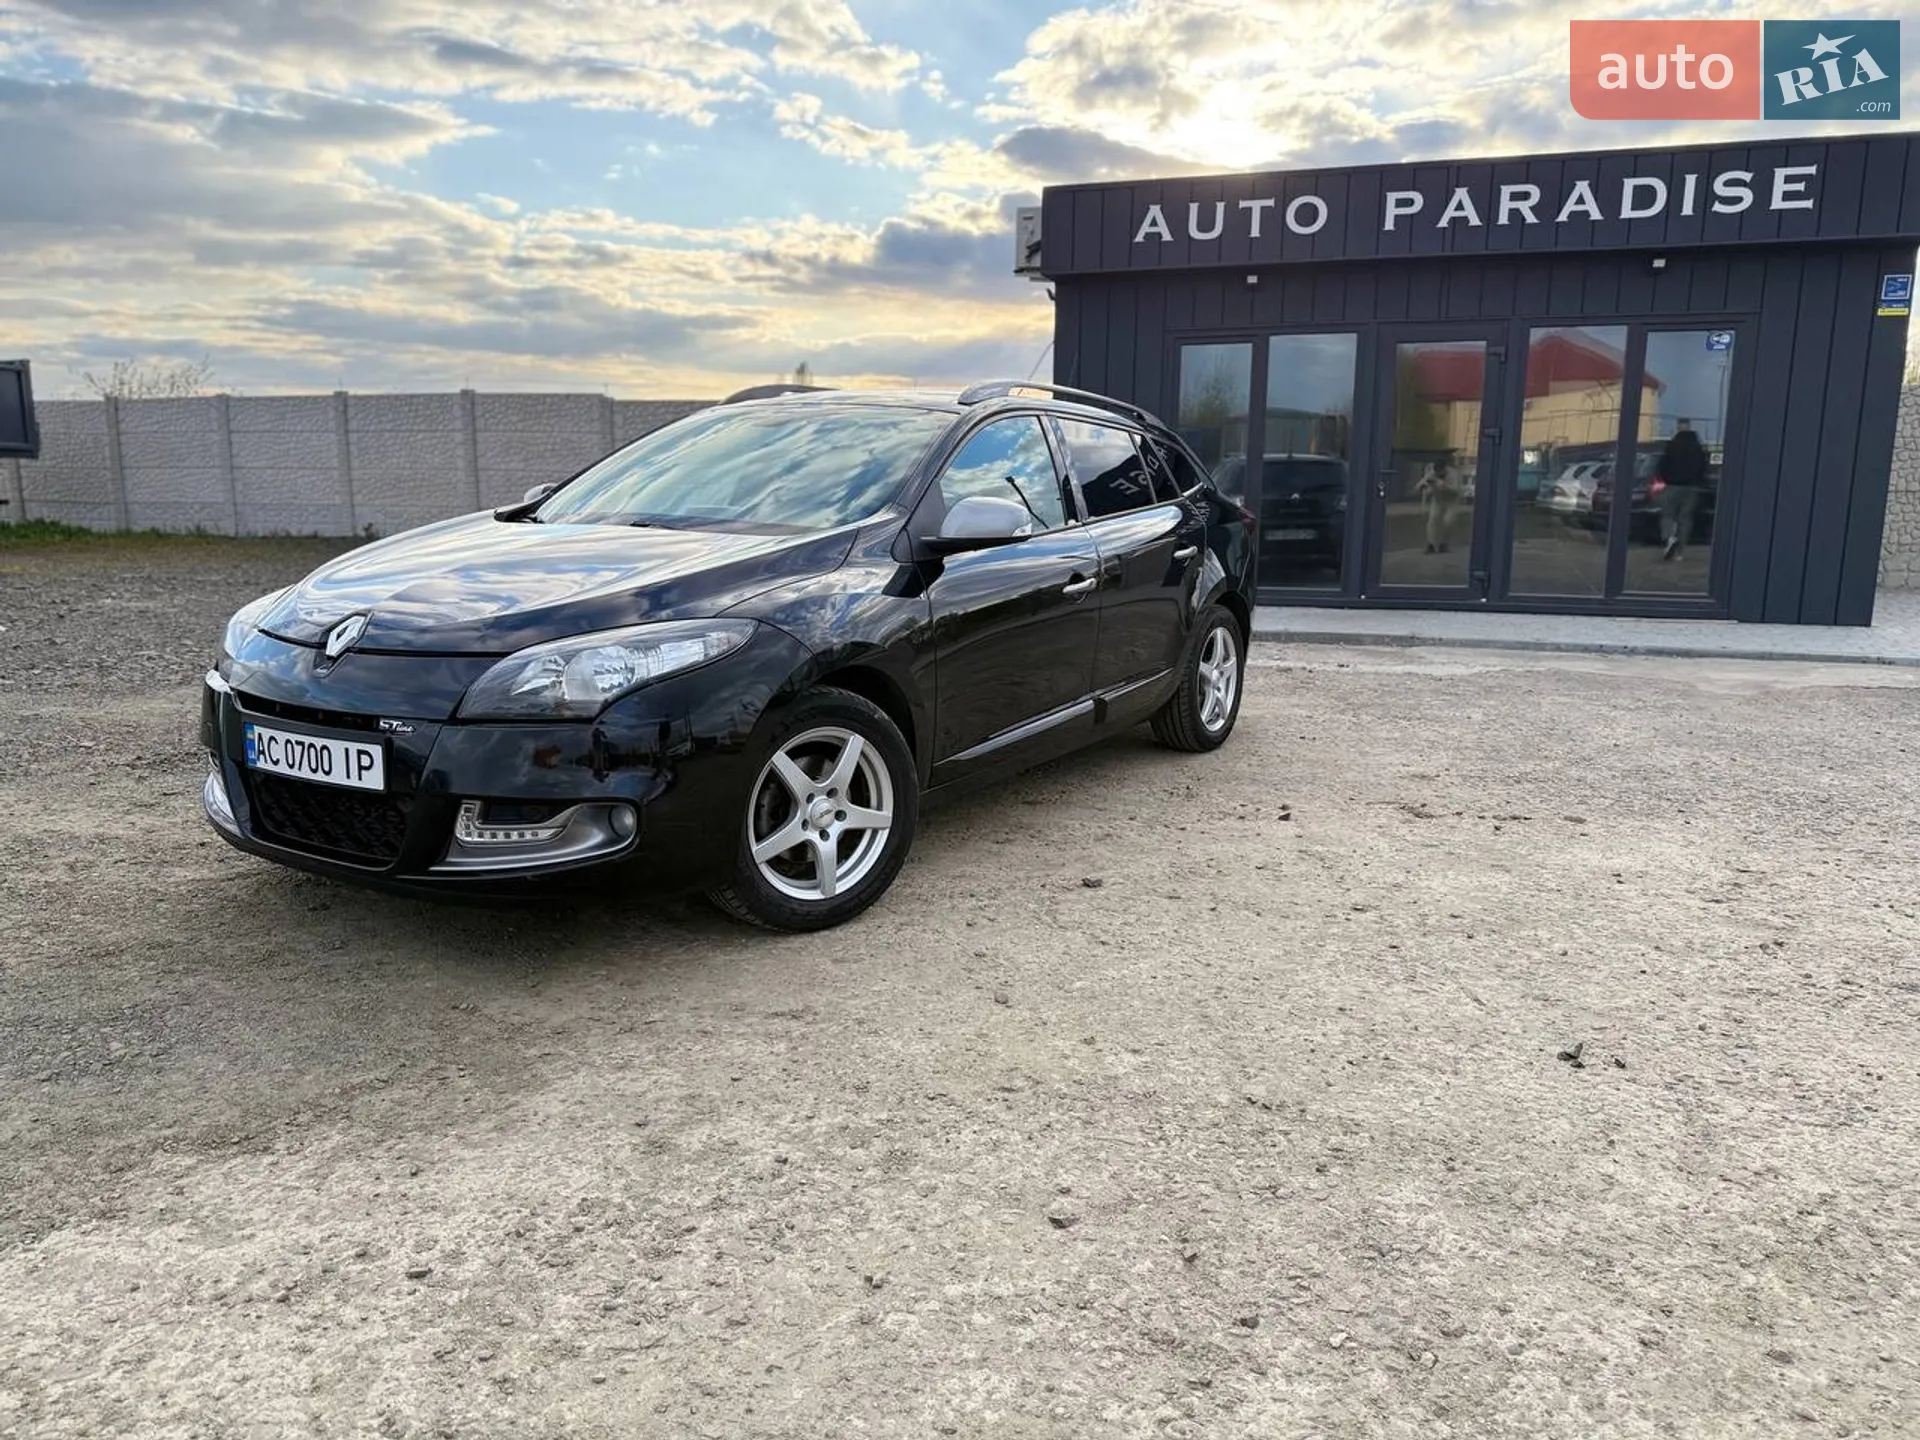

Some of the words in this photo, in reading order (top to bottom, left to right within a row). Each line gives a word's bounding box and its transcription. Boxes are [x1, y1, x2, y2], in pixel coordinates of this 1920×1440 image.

[1133, 195, 1328, 243] AUTO
[1383, 163, 1818, 231] PARADISE
[256, 732, 280, 766] AC
[284, 738, 332, 776] 0700
[344, 747, 374, 781] IP
